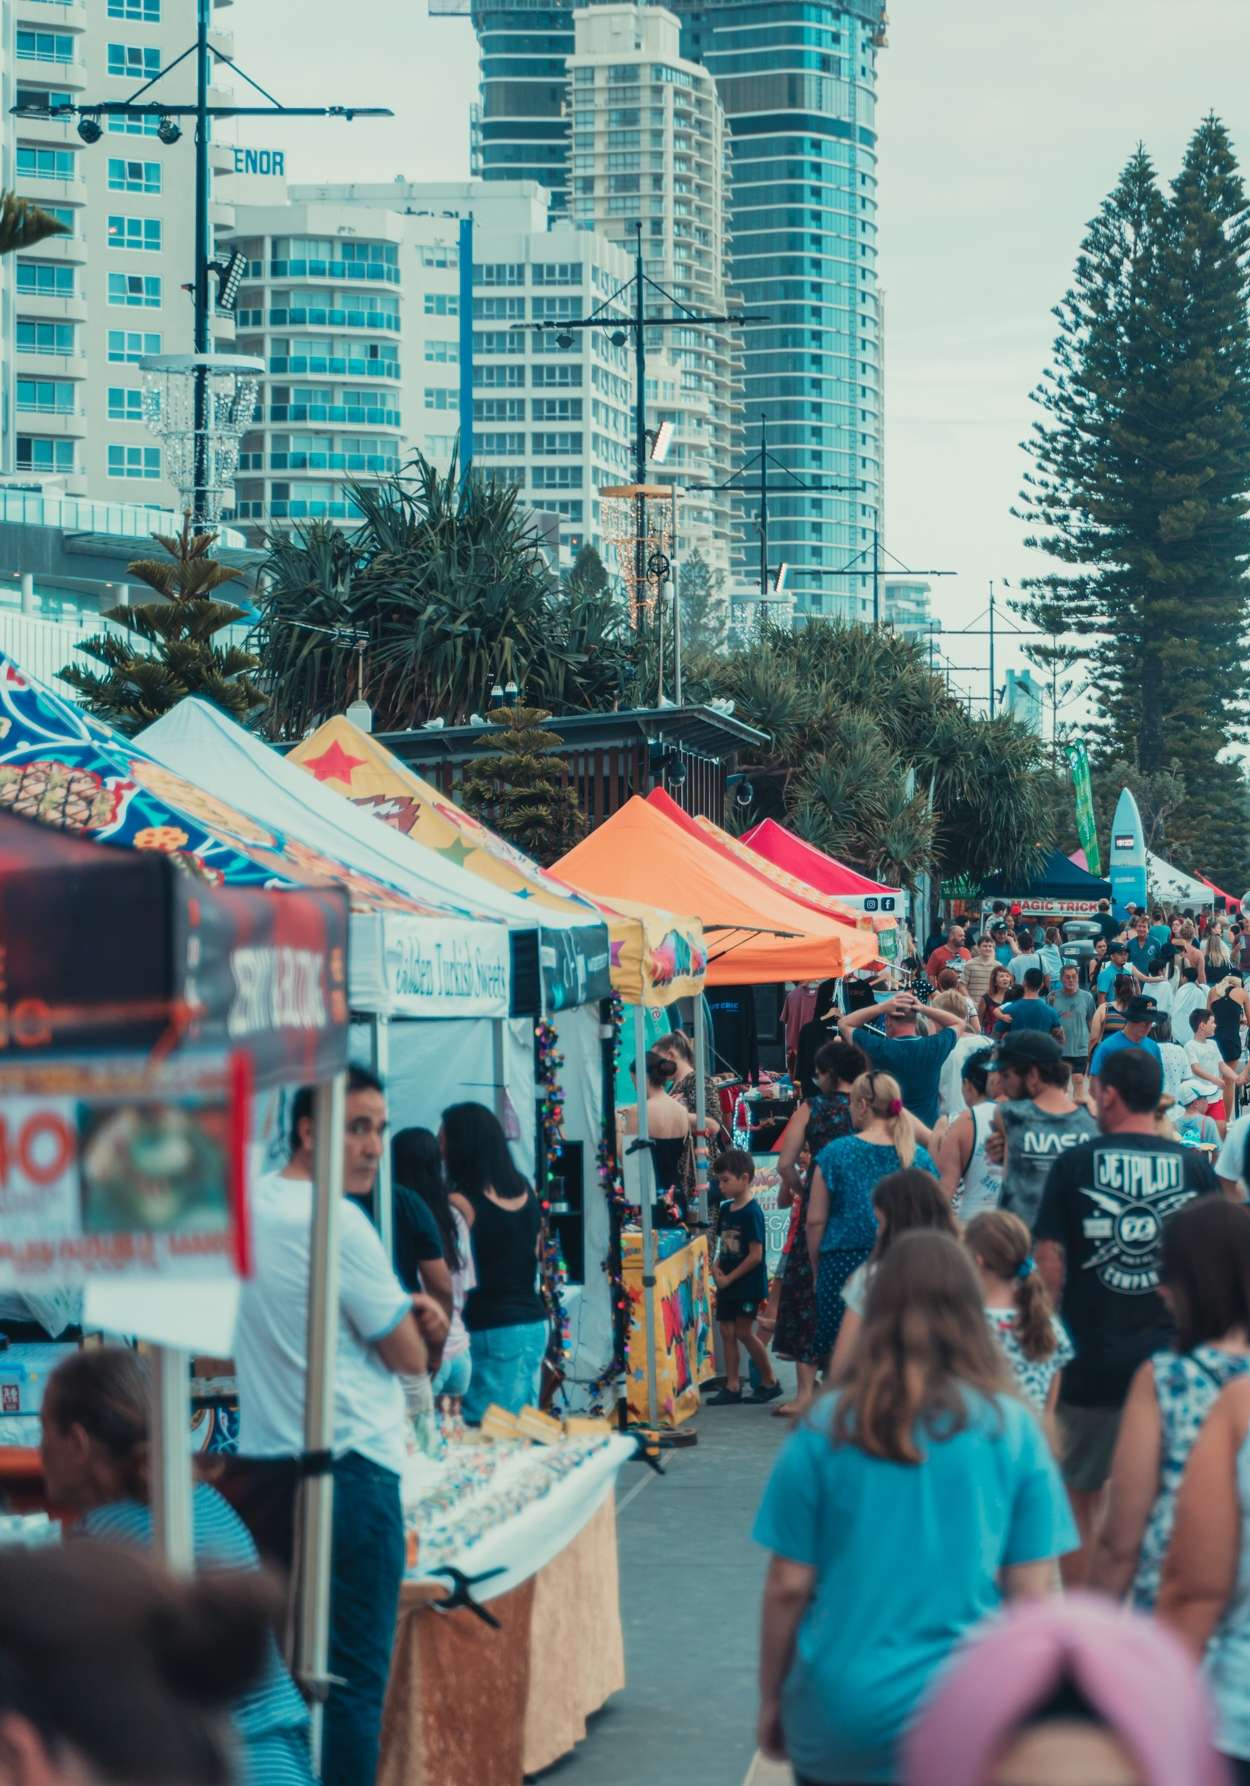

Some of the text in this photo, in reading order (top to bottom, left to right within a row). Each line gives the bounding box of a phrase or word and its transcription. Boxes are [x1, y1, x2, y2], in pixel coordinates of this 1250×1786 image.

[234, 149, 285, 176] ENOR
[1100, 1154, 1179, 1197] JETPILOT
[1103, 1267, 1160, 1290] COMPAN
